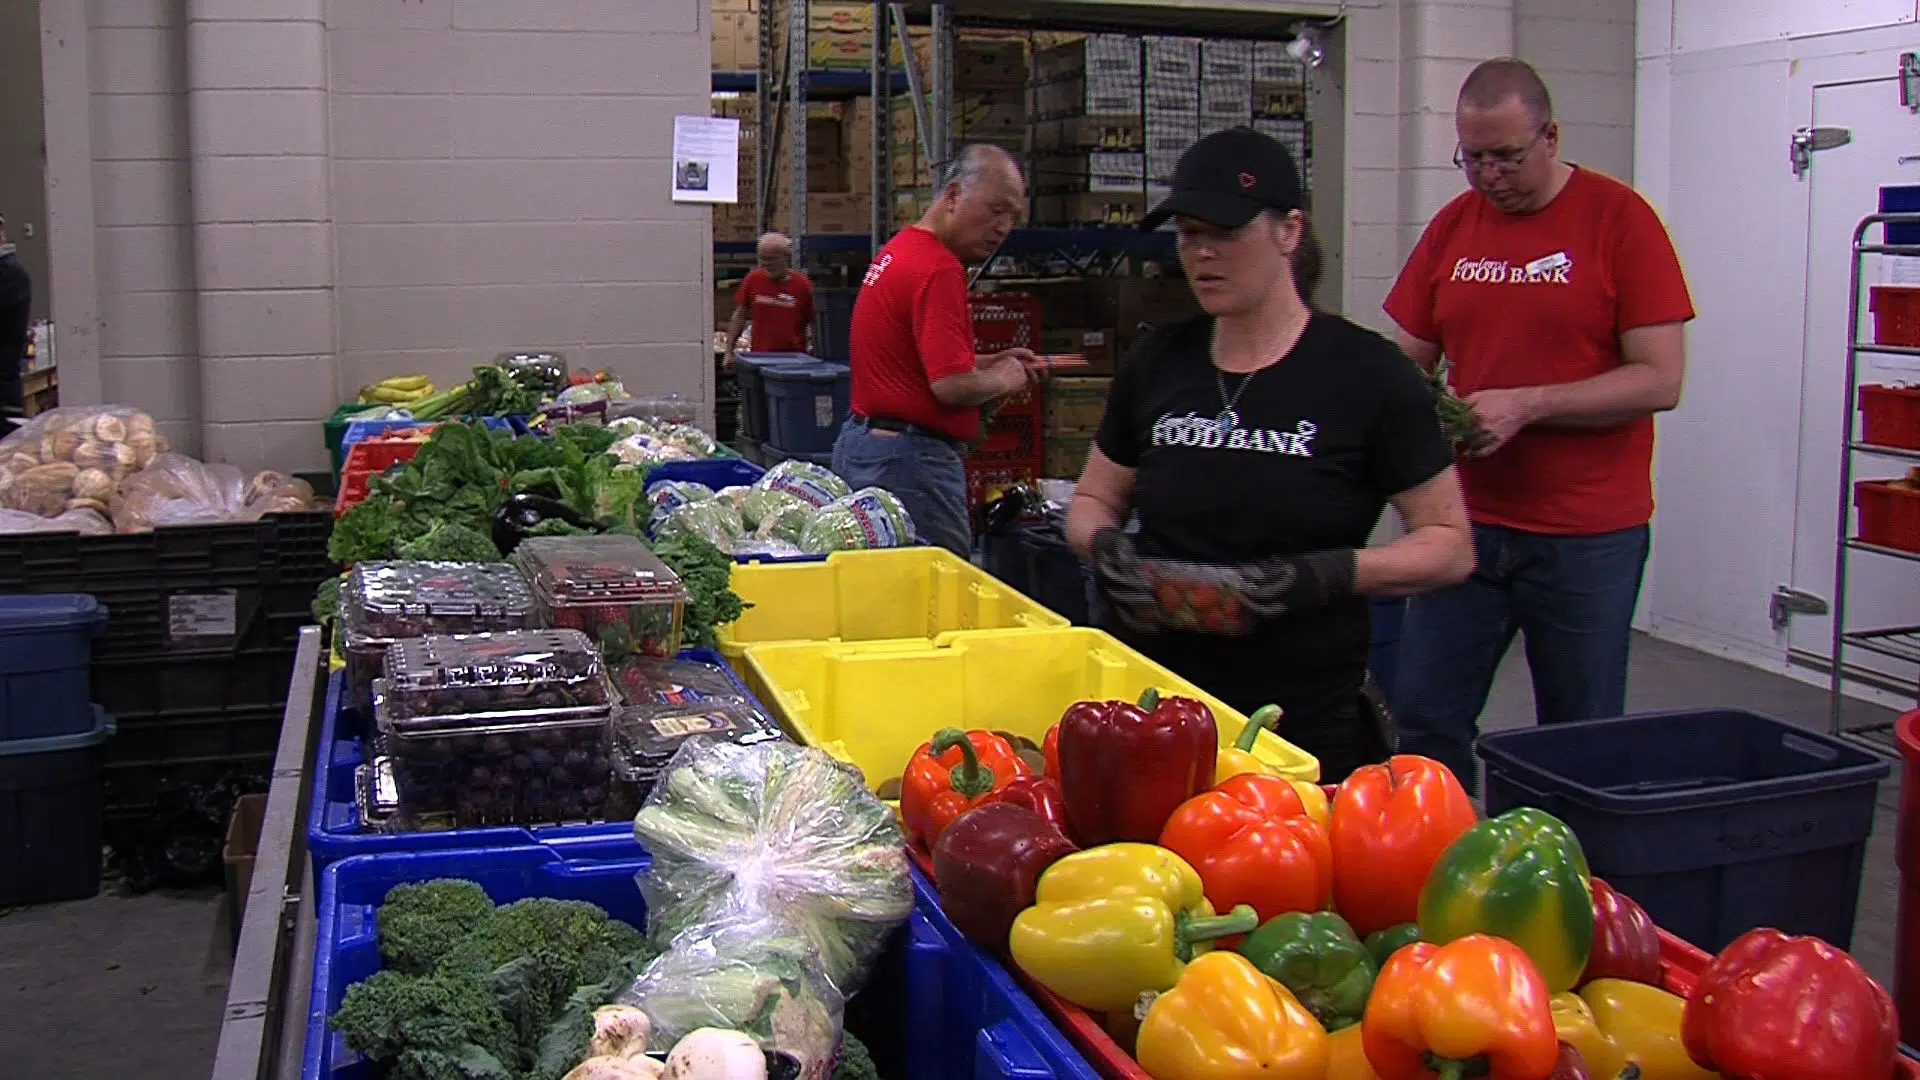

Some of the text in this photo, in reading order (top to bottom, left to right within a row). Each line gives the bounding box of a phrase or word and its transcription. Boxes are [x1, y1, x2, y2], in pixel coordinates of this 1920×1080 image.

[1450, 266, 1507, 283] FOOD
[1152, 424, 1313, 457] FOOD BANK
